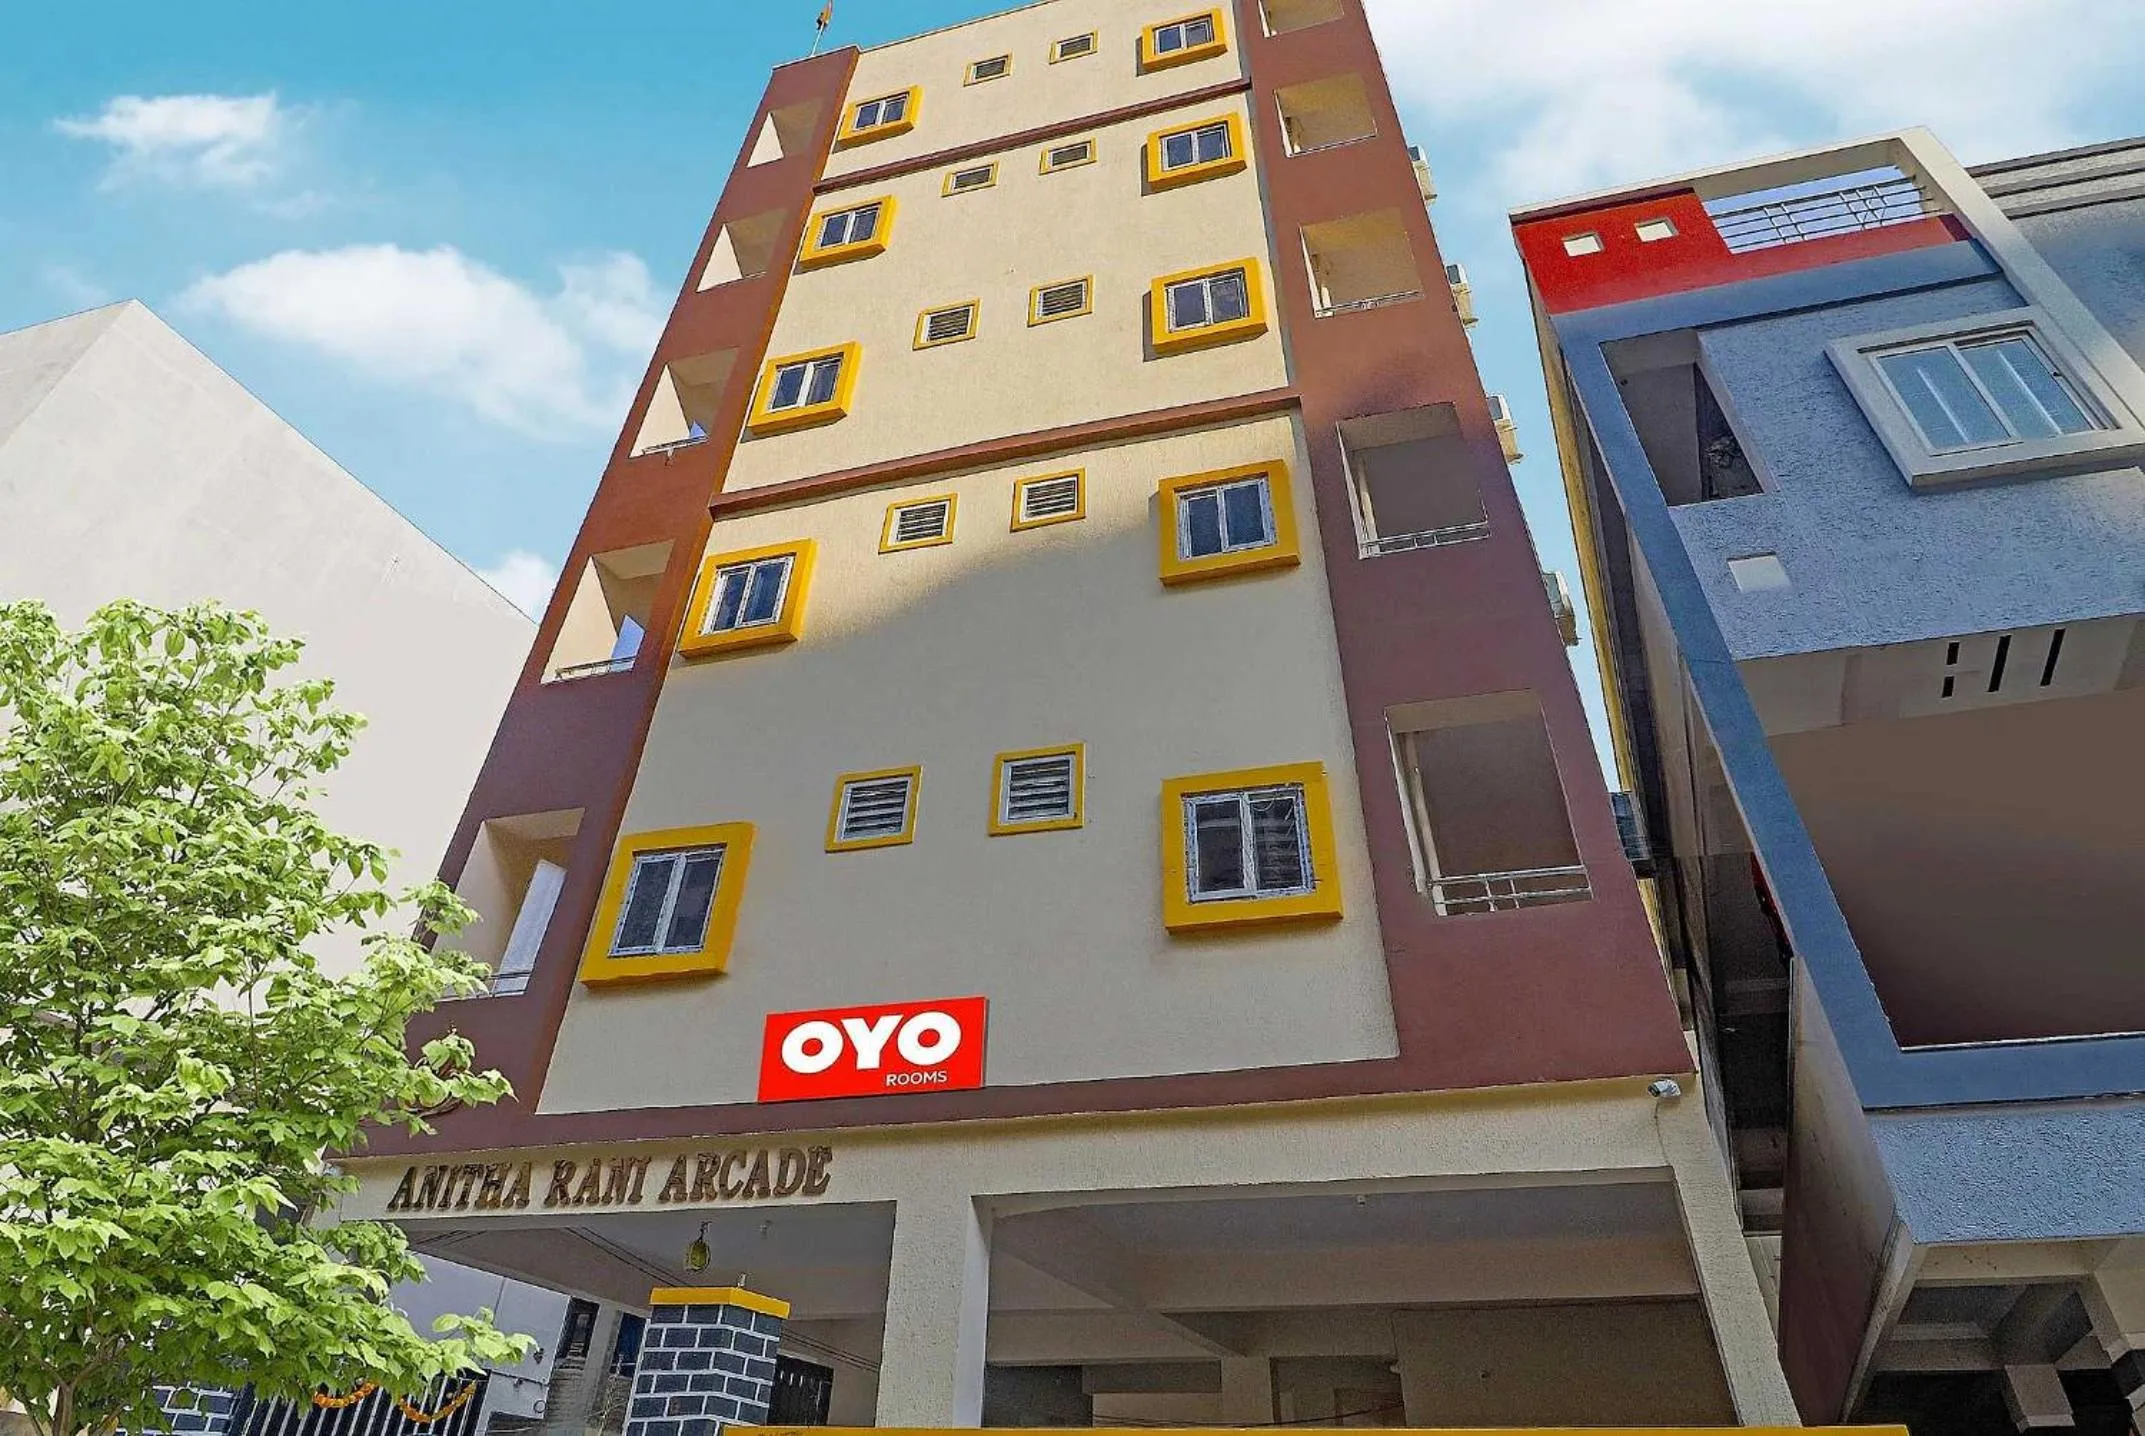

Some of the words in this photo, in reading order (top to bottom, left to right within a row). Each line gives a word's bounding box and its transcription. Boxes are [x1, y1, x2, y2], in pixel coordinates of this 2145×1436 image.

[781, 1011, 961, 1073] OYO
[886, 1071, 947, 1086] ROOMS
[387, 1162, 531, 1212] ANITHA
[544, 1156, 652, 1206] RANI
[659, 1146, 832, 1201] ARCADE
